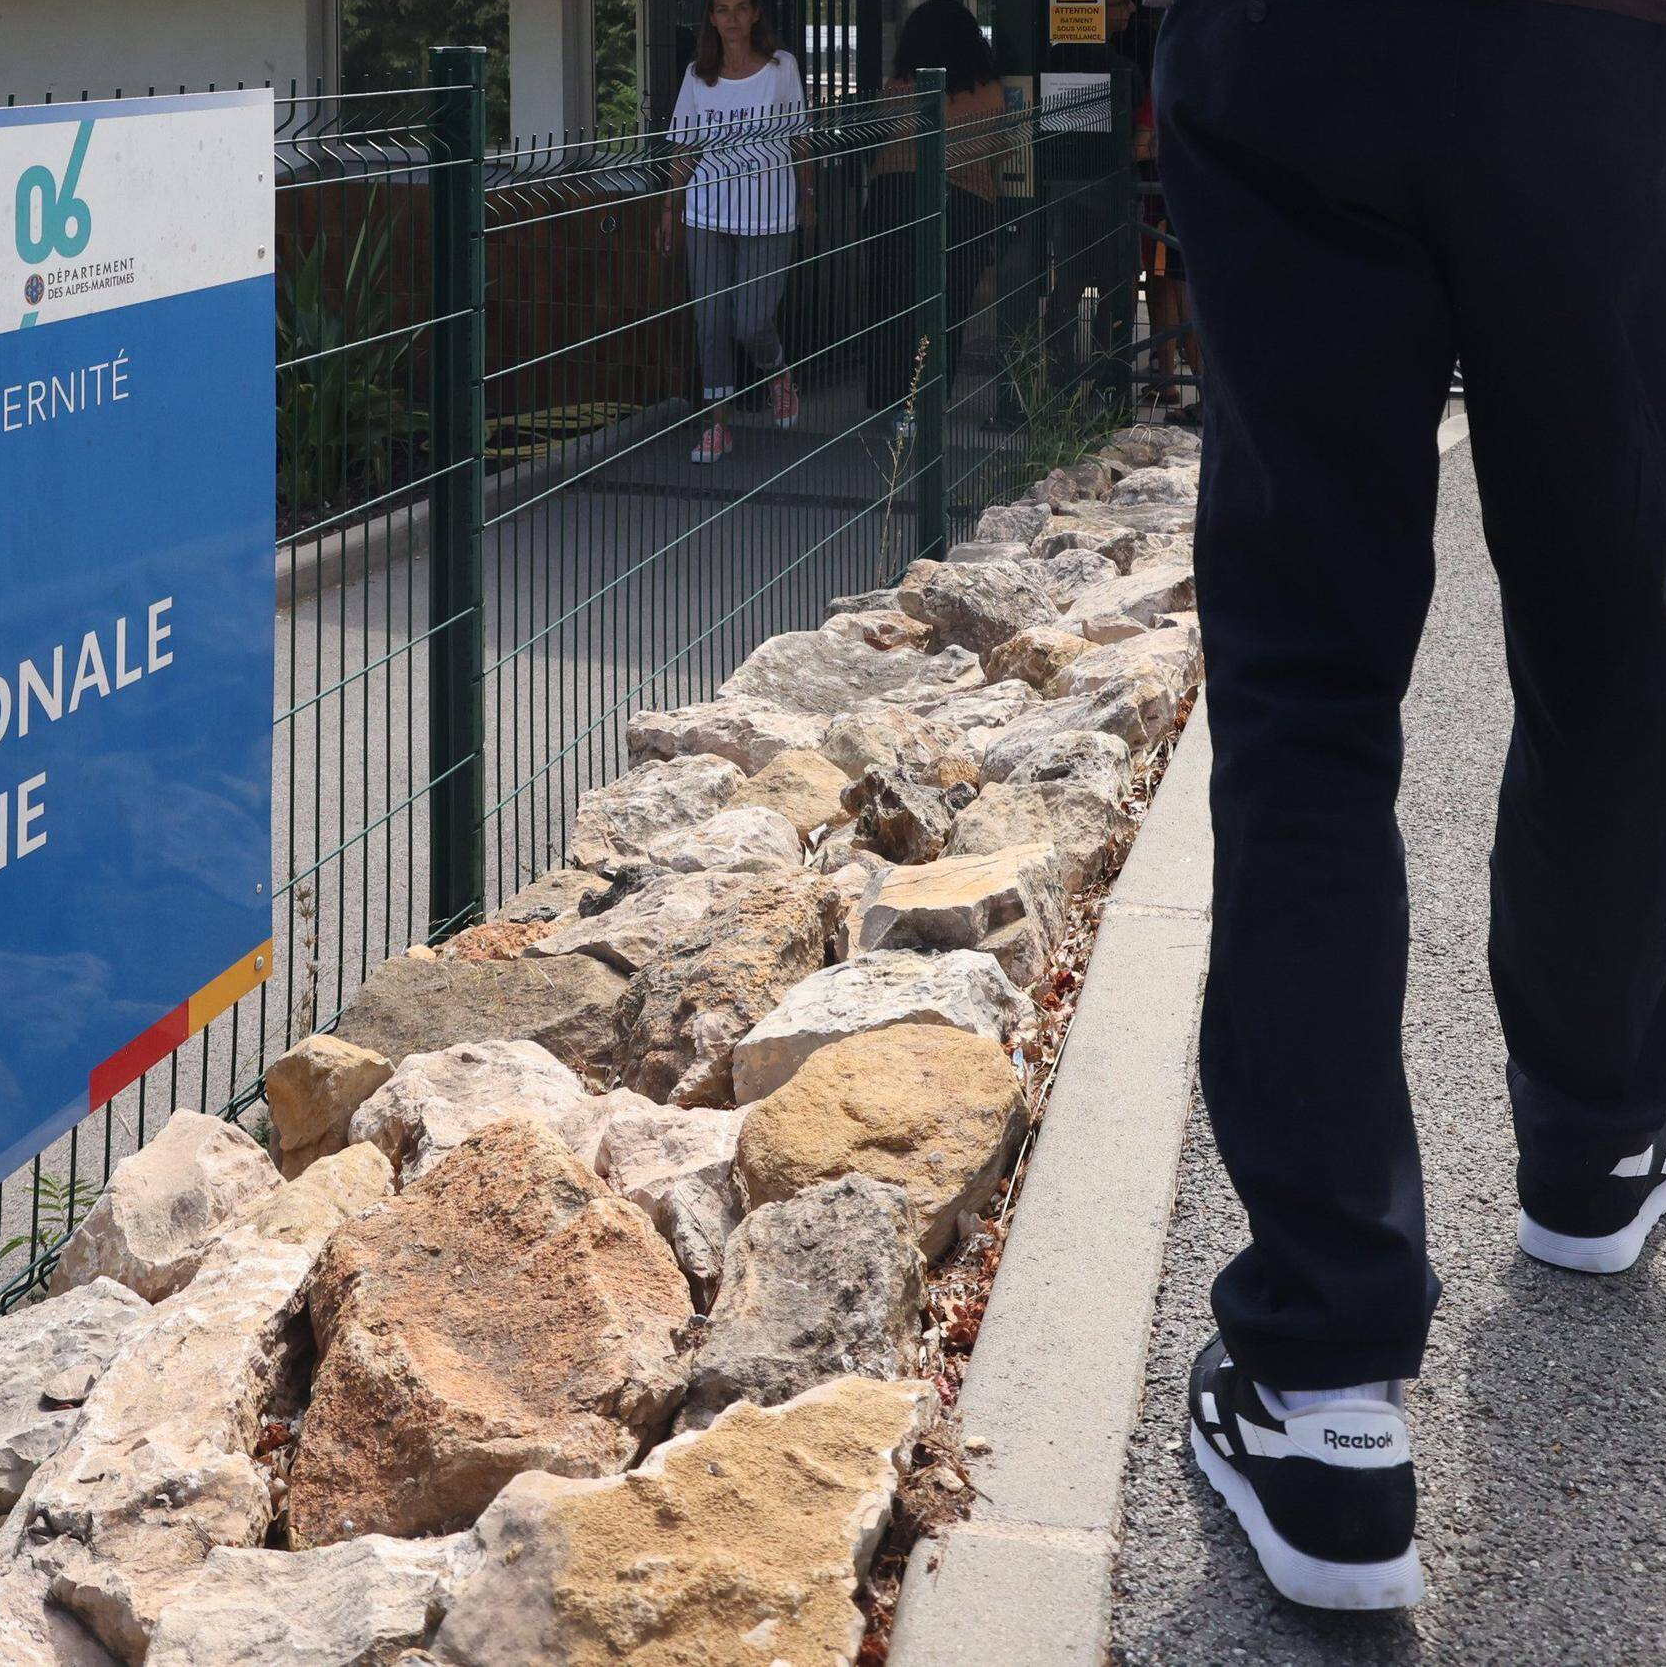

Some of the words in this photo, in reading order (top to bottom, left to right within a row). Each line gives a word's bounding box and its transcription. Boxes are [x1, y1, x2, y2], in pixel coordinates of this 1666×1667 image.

[15, 120, 95, 264] 06
[47, 257, 135, 285] DÉPARTEMENT
[48, 287, 63, 300] DES
[66, 273, 135, 296] ALPES-MARITIMES
[1323, 1428, 1394, 1450] Reebok
